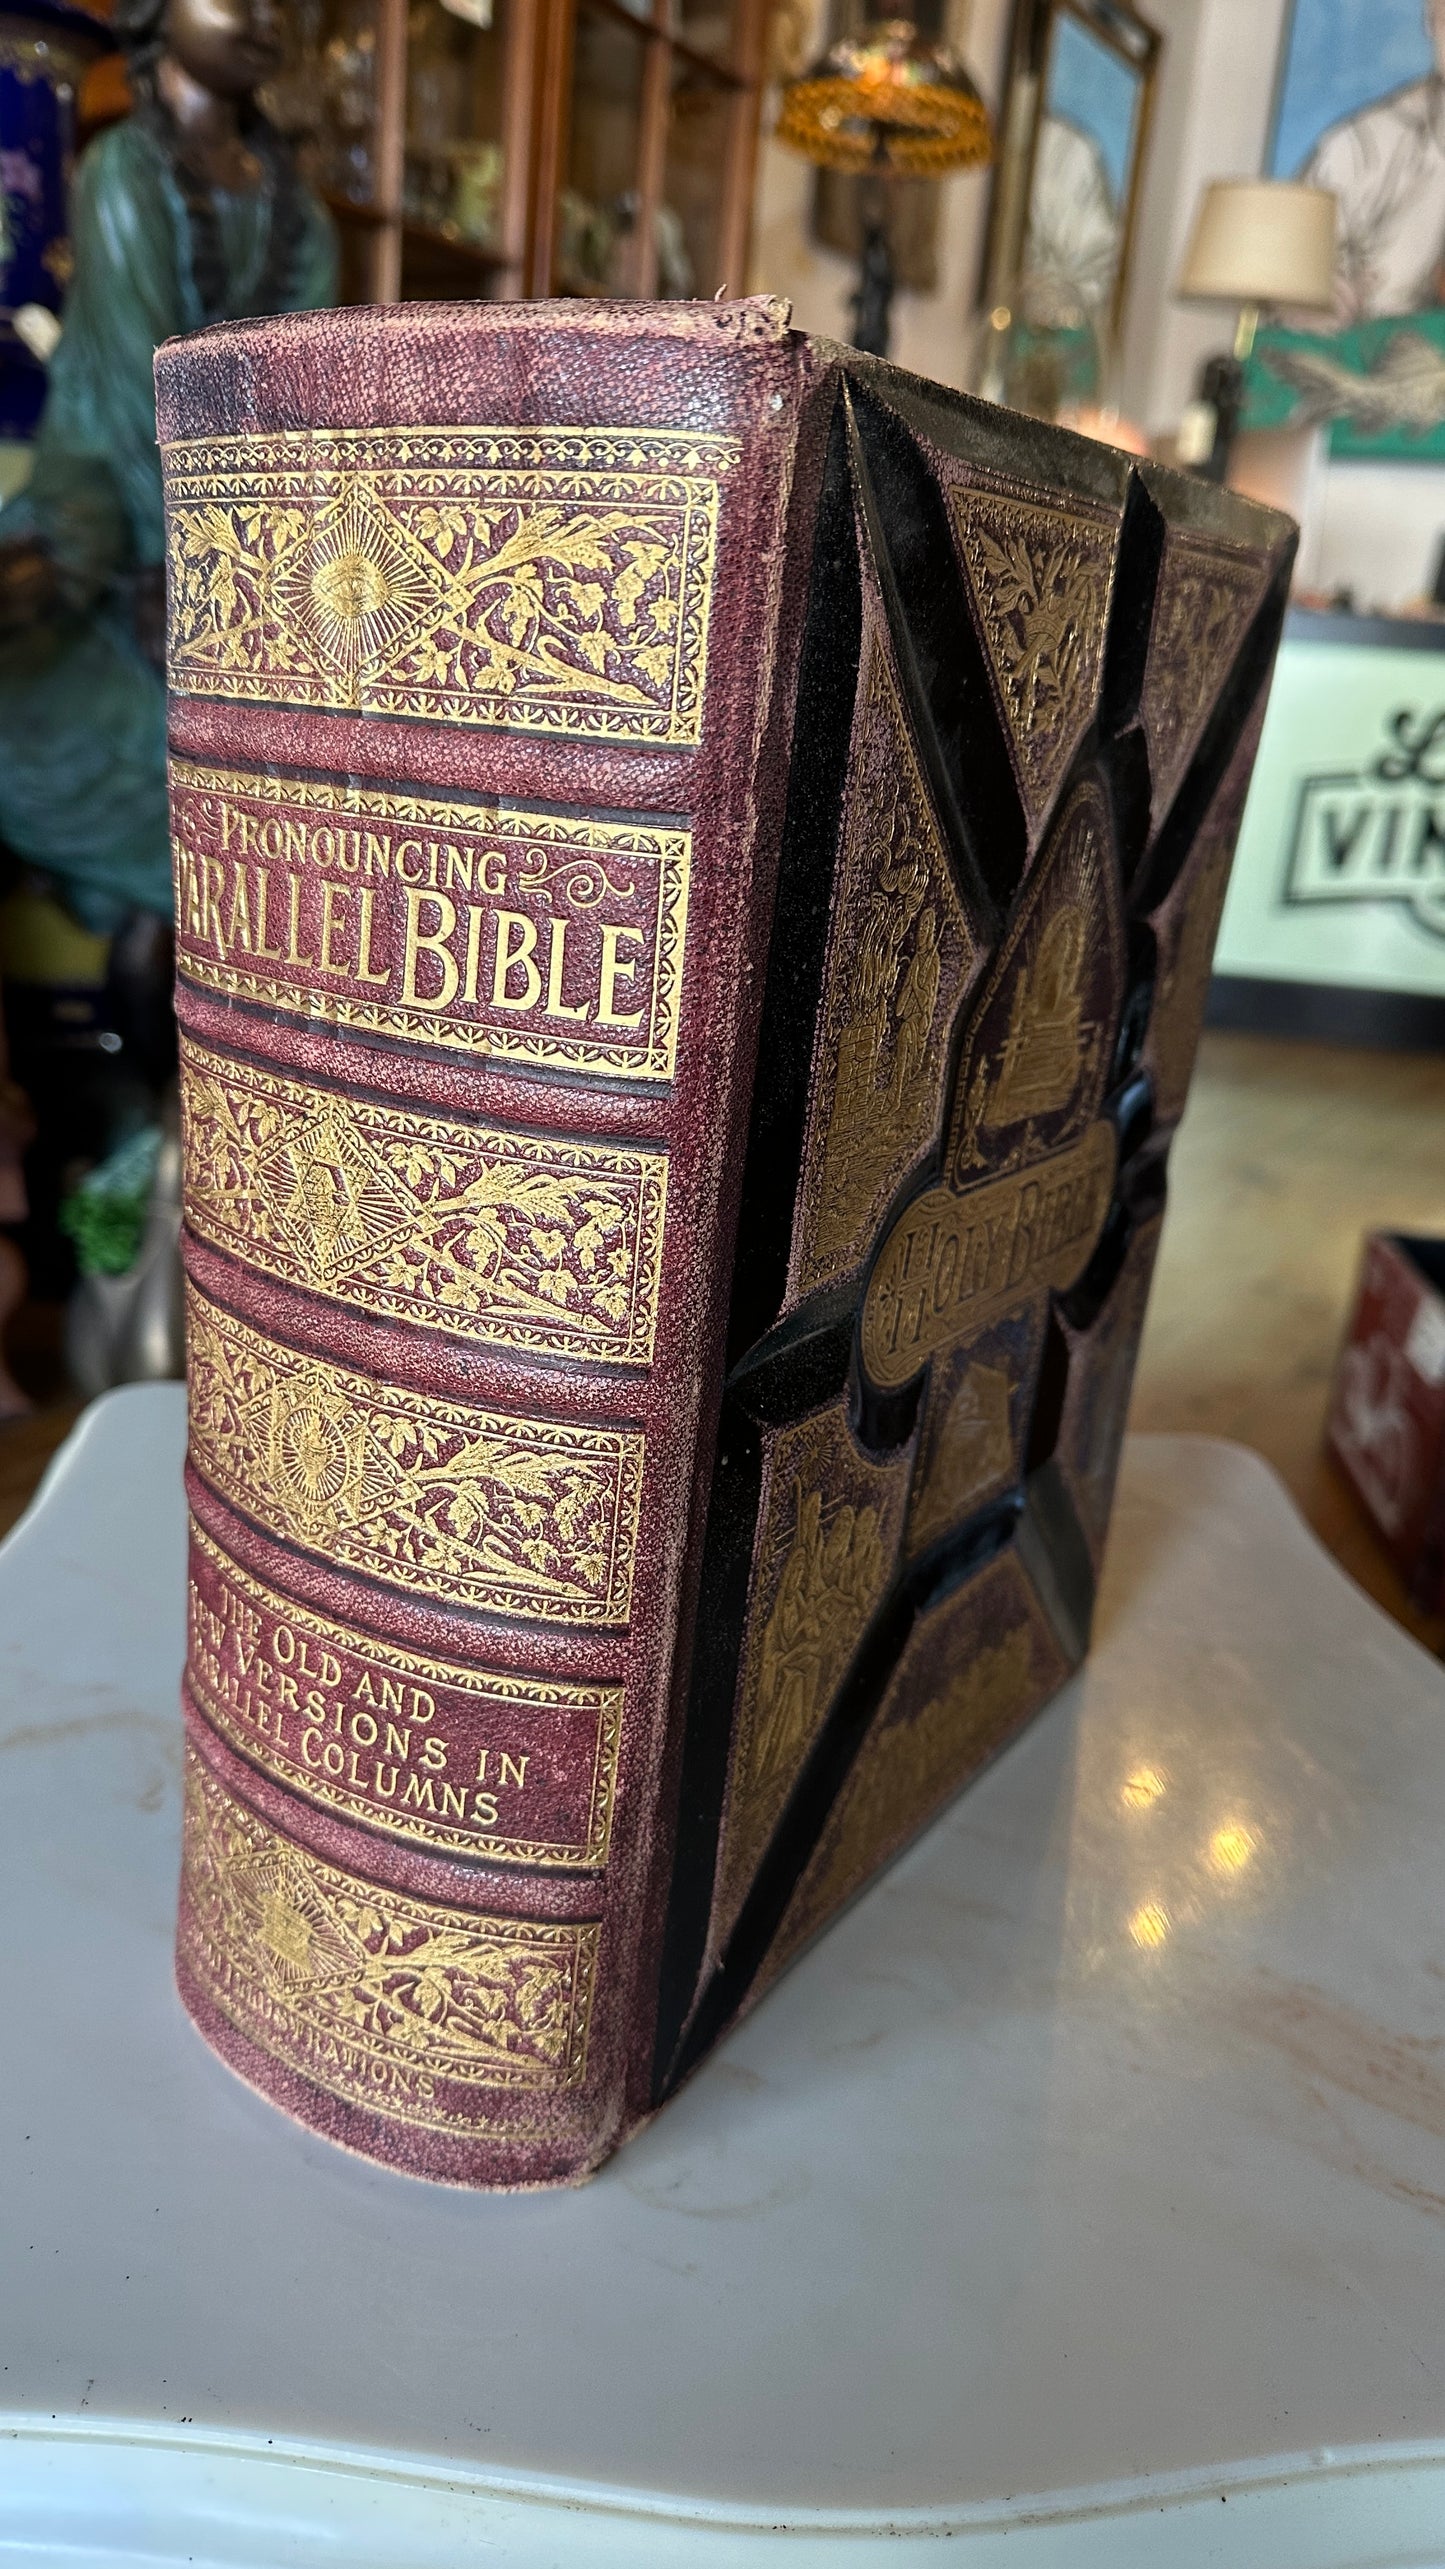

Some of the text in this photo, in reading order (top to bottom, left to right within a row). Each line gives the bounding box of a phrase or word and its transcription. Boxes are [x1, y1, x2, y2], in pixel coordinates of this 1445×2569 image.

[219, 800, 508, 896] PRONOUNCING
[397, 886, 646, 1028] BIBLE
[886, 1213, 1010, 1355] HOLY
[218, 1583, 437, 1724] THE OLD AND
[235, 1633, 449, 1771] VERSIONS
[474, 1749, 531, 1788] IN
[300, 1727, 501, 1827] COLUMNS
